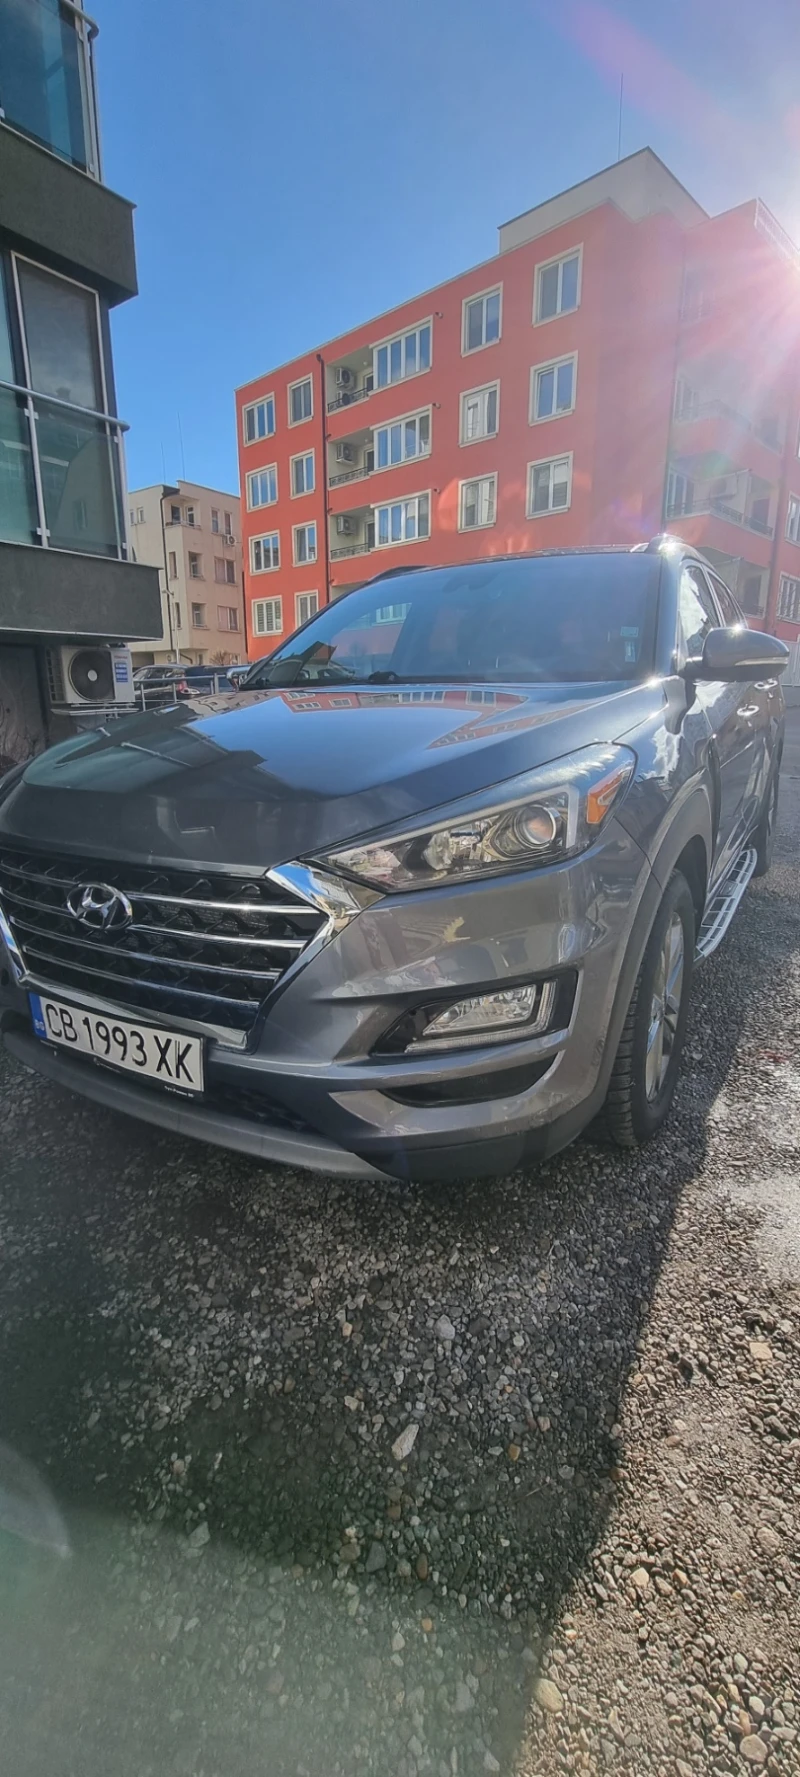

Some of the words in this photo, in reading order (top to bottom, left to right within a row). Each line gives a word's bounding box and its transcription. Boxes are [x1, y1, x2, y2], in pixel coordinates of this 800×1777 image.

[45, 1004, 78, 1042] CB
[83, 1017, 147, 1066] 1993
[154, 1035, 194, 1084] XK
